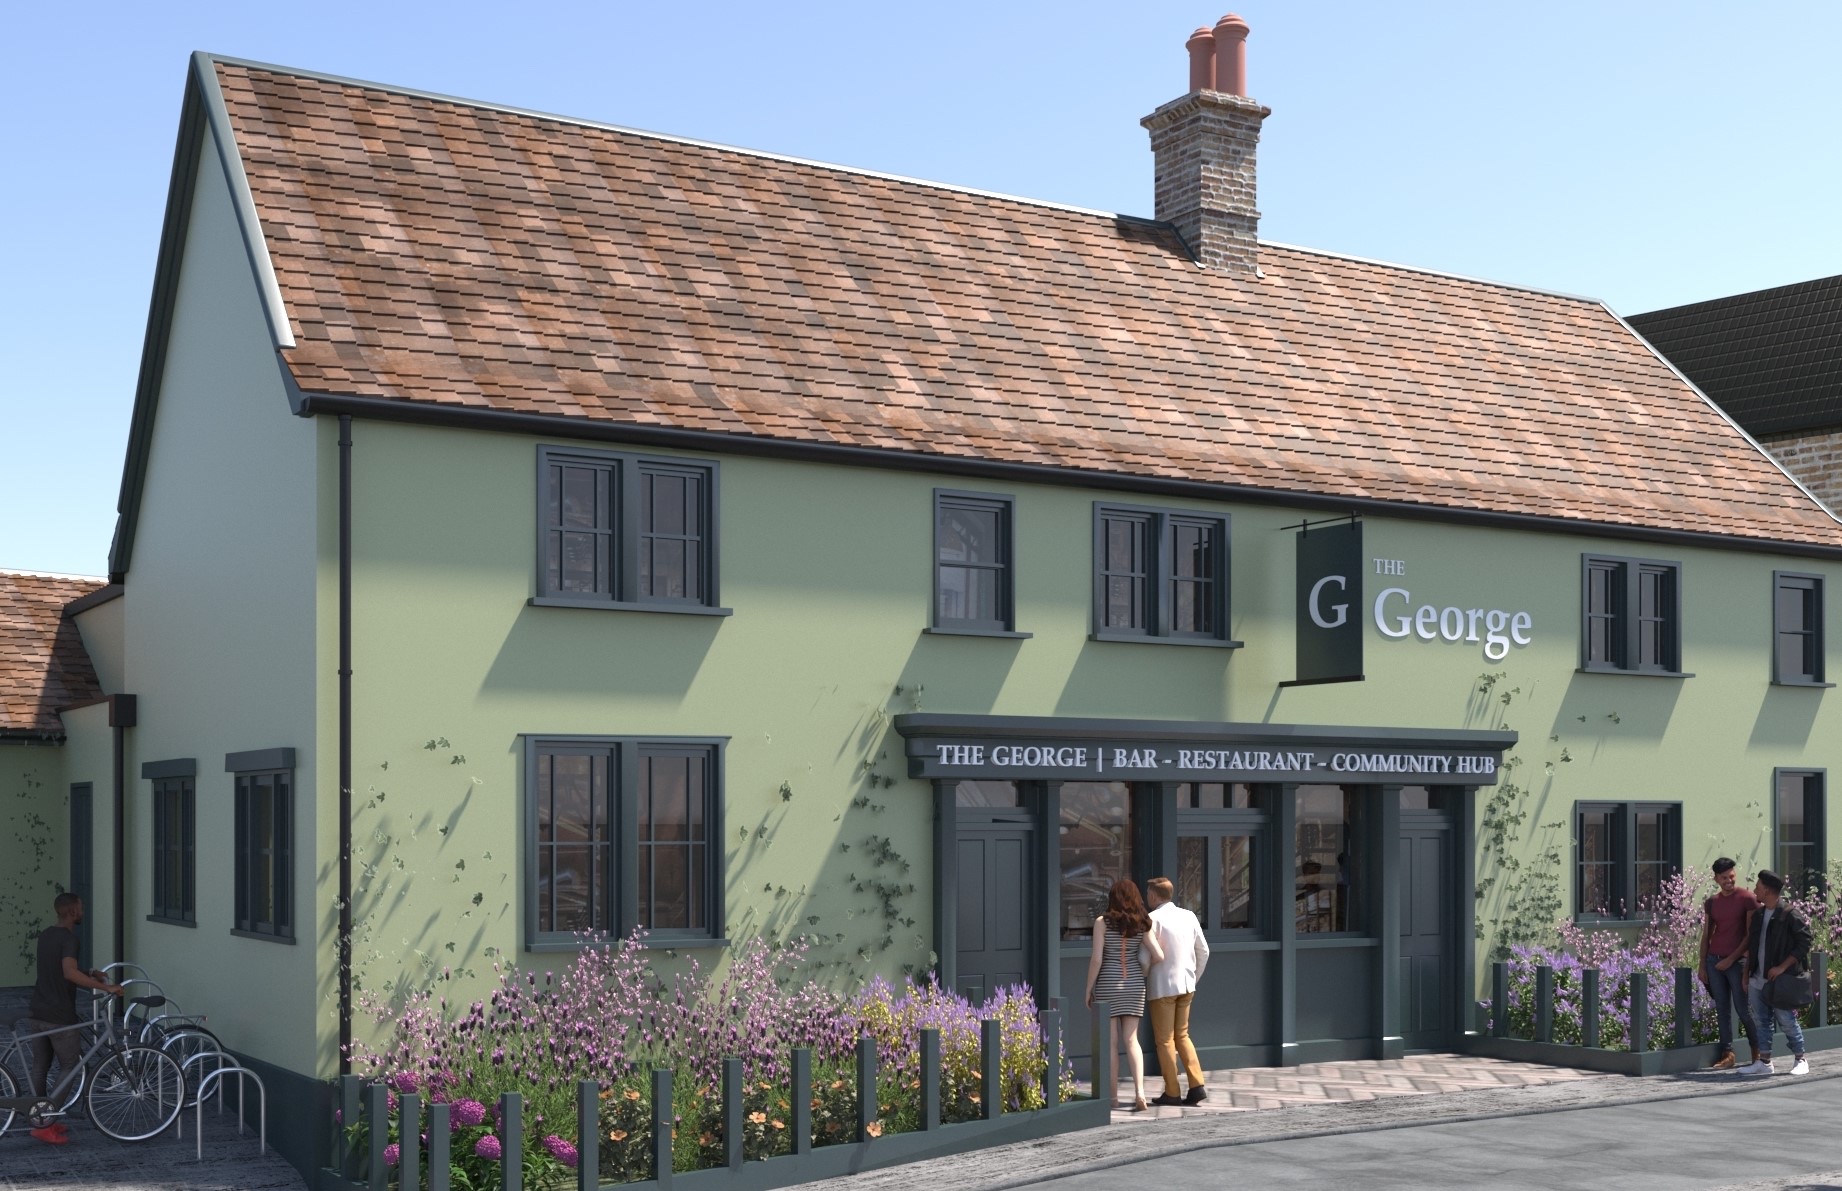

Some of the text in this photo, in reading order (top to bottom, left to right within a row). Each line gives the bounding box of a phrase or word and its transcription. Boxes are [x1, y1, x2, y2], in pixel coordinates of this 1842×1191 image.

[1373, 558, 1406, 576] THE
[1308, 575, 1349, 629] G
[1374, 587, 1533, 660] George
[937, 745, 985, 766] THE
[991, 746, 1087, 767] GEORGE
[1112, 749, 1158, 768] BAR
[1177, 750, 1315, 771] RESTAURANT
[1331, 753, 1452, 773] COMMUNITY
[1457, 756, 1496, 774] HUB
